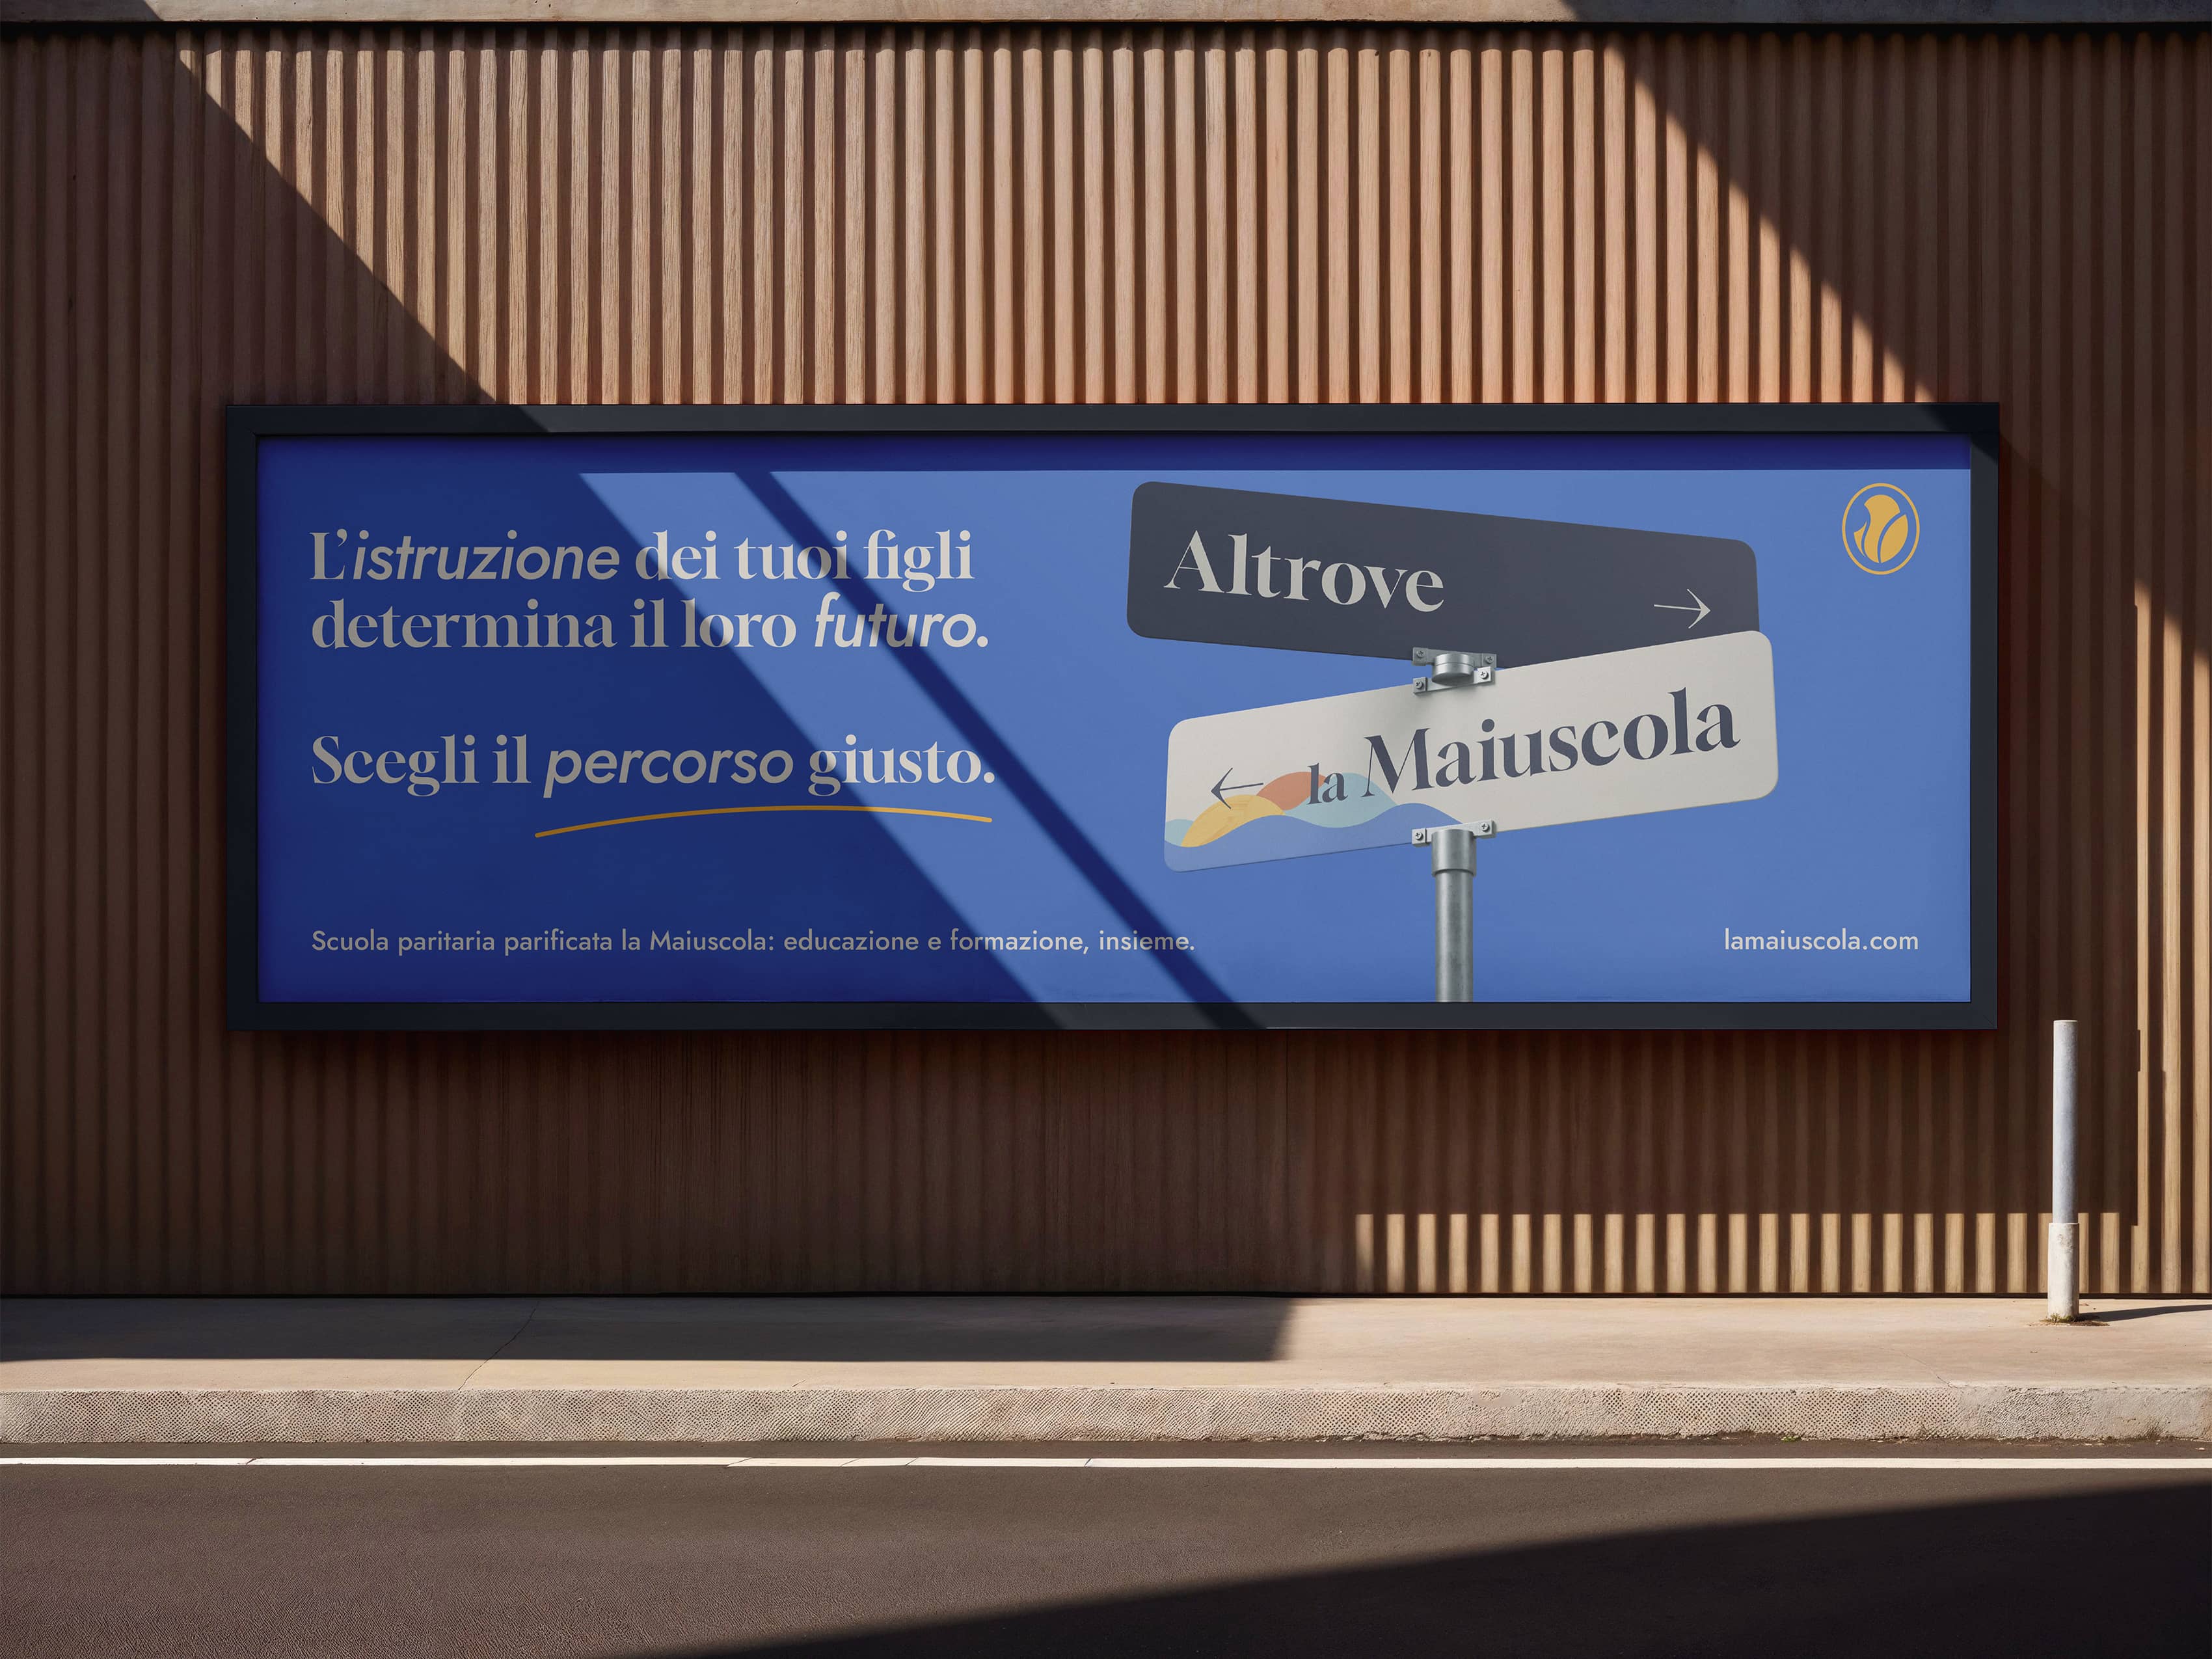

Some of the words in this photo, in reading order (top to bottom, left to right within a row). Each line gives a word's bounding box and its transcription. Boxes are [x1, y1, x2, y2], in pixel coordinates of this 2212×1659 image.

[635, 530, 720, 581] dei
[734, 530, 850, 581] tuoi
[863, 529, 974, 593] figli
[1163, 530, 1444, 612] Altrove
[312, 599, 615, 649] determina
[630, 598, 668, 648] il
[681, 598, 796, 649] loro
[815, 591, 989, 649] futuro.
[312, 735, 478, 797] Scegli
[494, 735, 530, 783] il
[543, 749, 794, 798] percorso
[808, 734, 995, 796] giusto.
[1308, 762, 1347, 805] la
[1362, 686, 1741, 798] Maiuscola
[312, 928, 388, 951] Scuola
[399, 929, 494, 956] paritaria
[505, 928, 612, 956] parificata
[622, 928, 640, 951] la
[650, 928, 774, 951] Maiuscola:
[784, 928, 919, 951] educazione
[928, 936, 941, 951] e
[951, 928, 1089, 955] formazione,
[1099, 928, 1194, 951] insieme.
[1725, 927, 1919, 951] lamaiuscola.com
